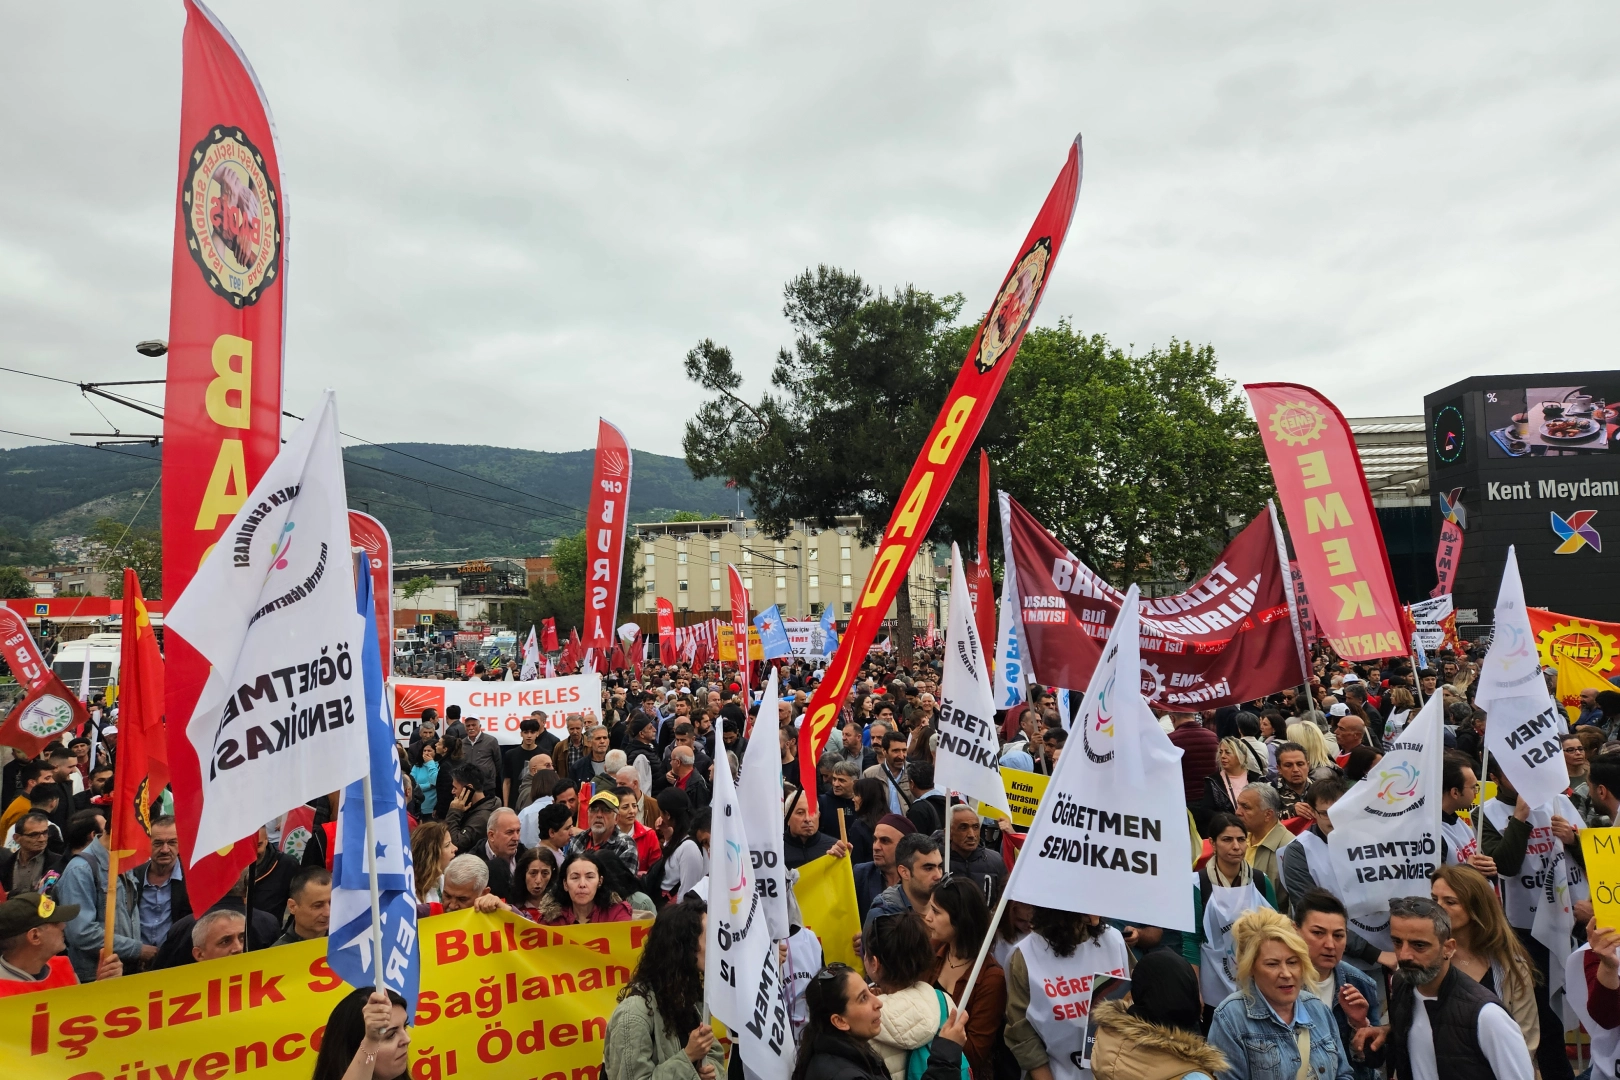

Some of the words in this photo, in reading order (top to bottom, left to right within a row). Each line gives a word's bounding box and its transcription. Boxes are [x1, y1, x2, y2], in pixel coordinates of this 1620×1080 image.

[1487, 481, 1532, 501] Kent
[1537, 477, 1620, 504] Meydanı
[457, 565, 492, 574] SARANDA
[1027, 610, 1066, 623] MAYIS!
[468, 691, 512, 707] CHP
[518, 686, 581, 706] KELES
[1005, 791, 1039, 806] aturasını
[1011, 781, 1034, 793] Krizin
[1051, 791, 1161, 842] ÖĞRETMEN
[1038, 833, 1158, 876] SENDİKASI
[413, 964, 631, 1027] Sağlanan
[30, 970, 287, 1060] İşsizlik
